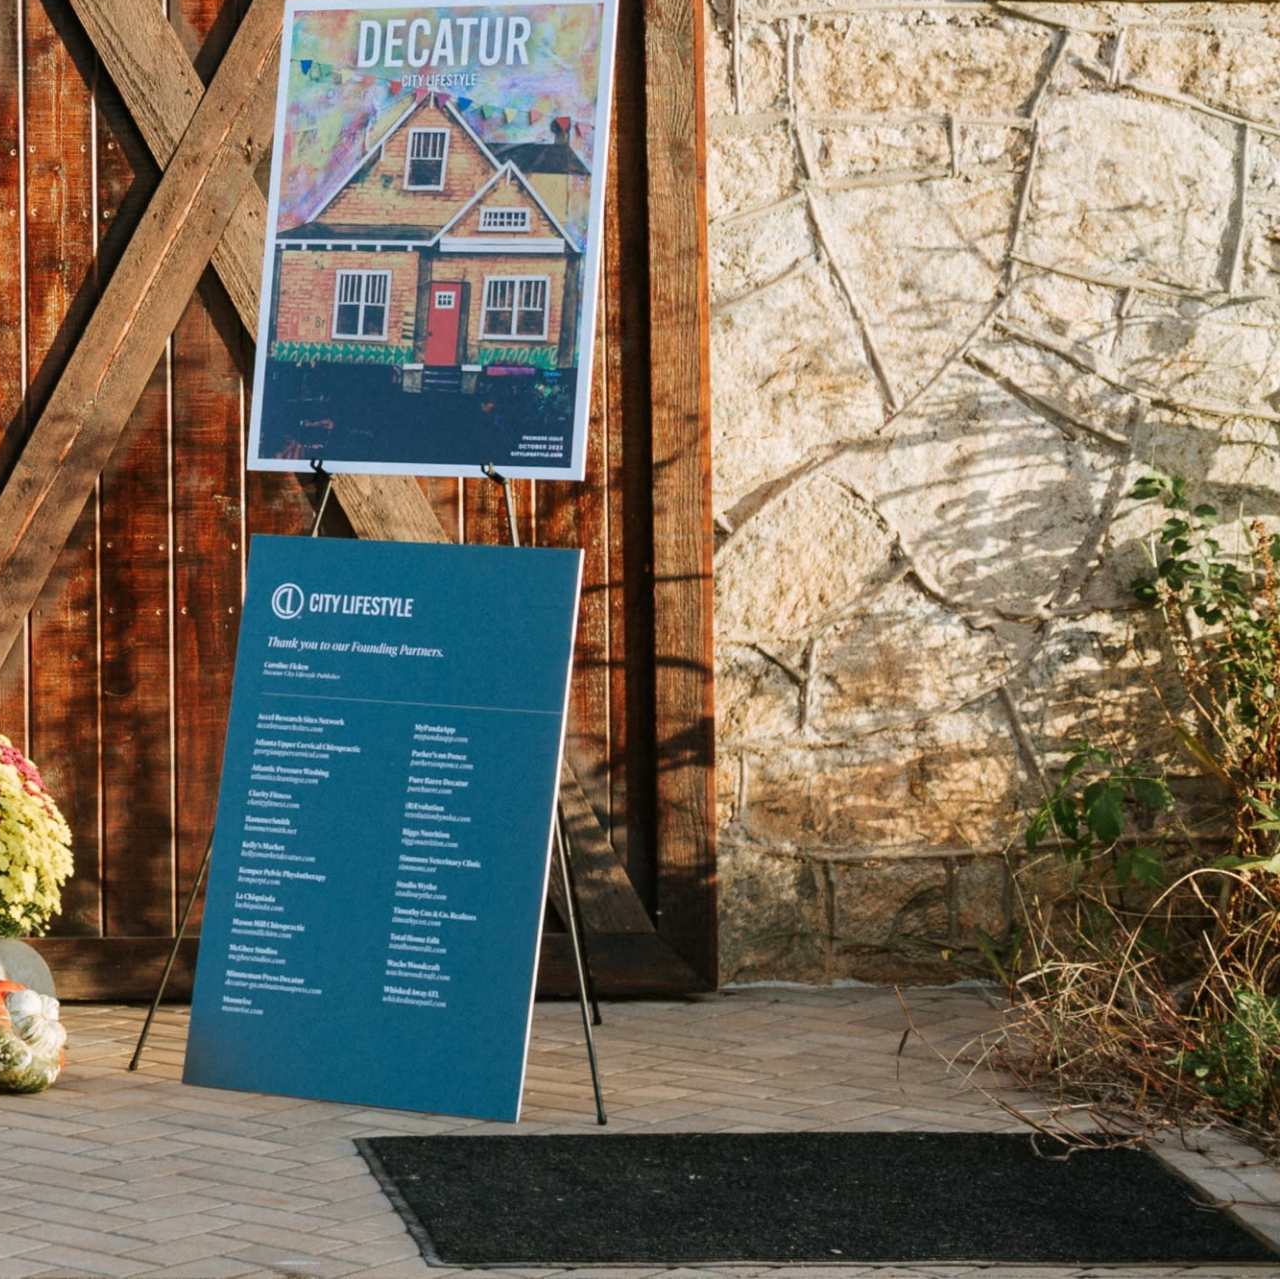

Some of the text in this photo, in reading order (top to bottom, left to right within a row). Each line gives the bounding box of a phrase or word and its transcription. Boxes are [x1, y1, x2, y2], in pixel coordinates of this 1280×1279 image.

[356, 15, 532, 68] DECATUR
[401, 73, 477, 88] CITY LIFESTYLE
[309, 593, 414, 617] CITY LIFESTYLE
[267, 637, 444, 656] Thank you to our Founding Partners.
